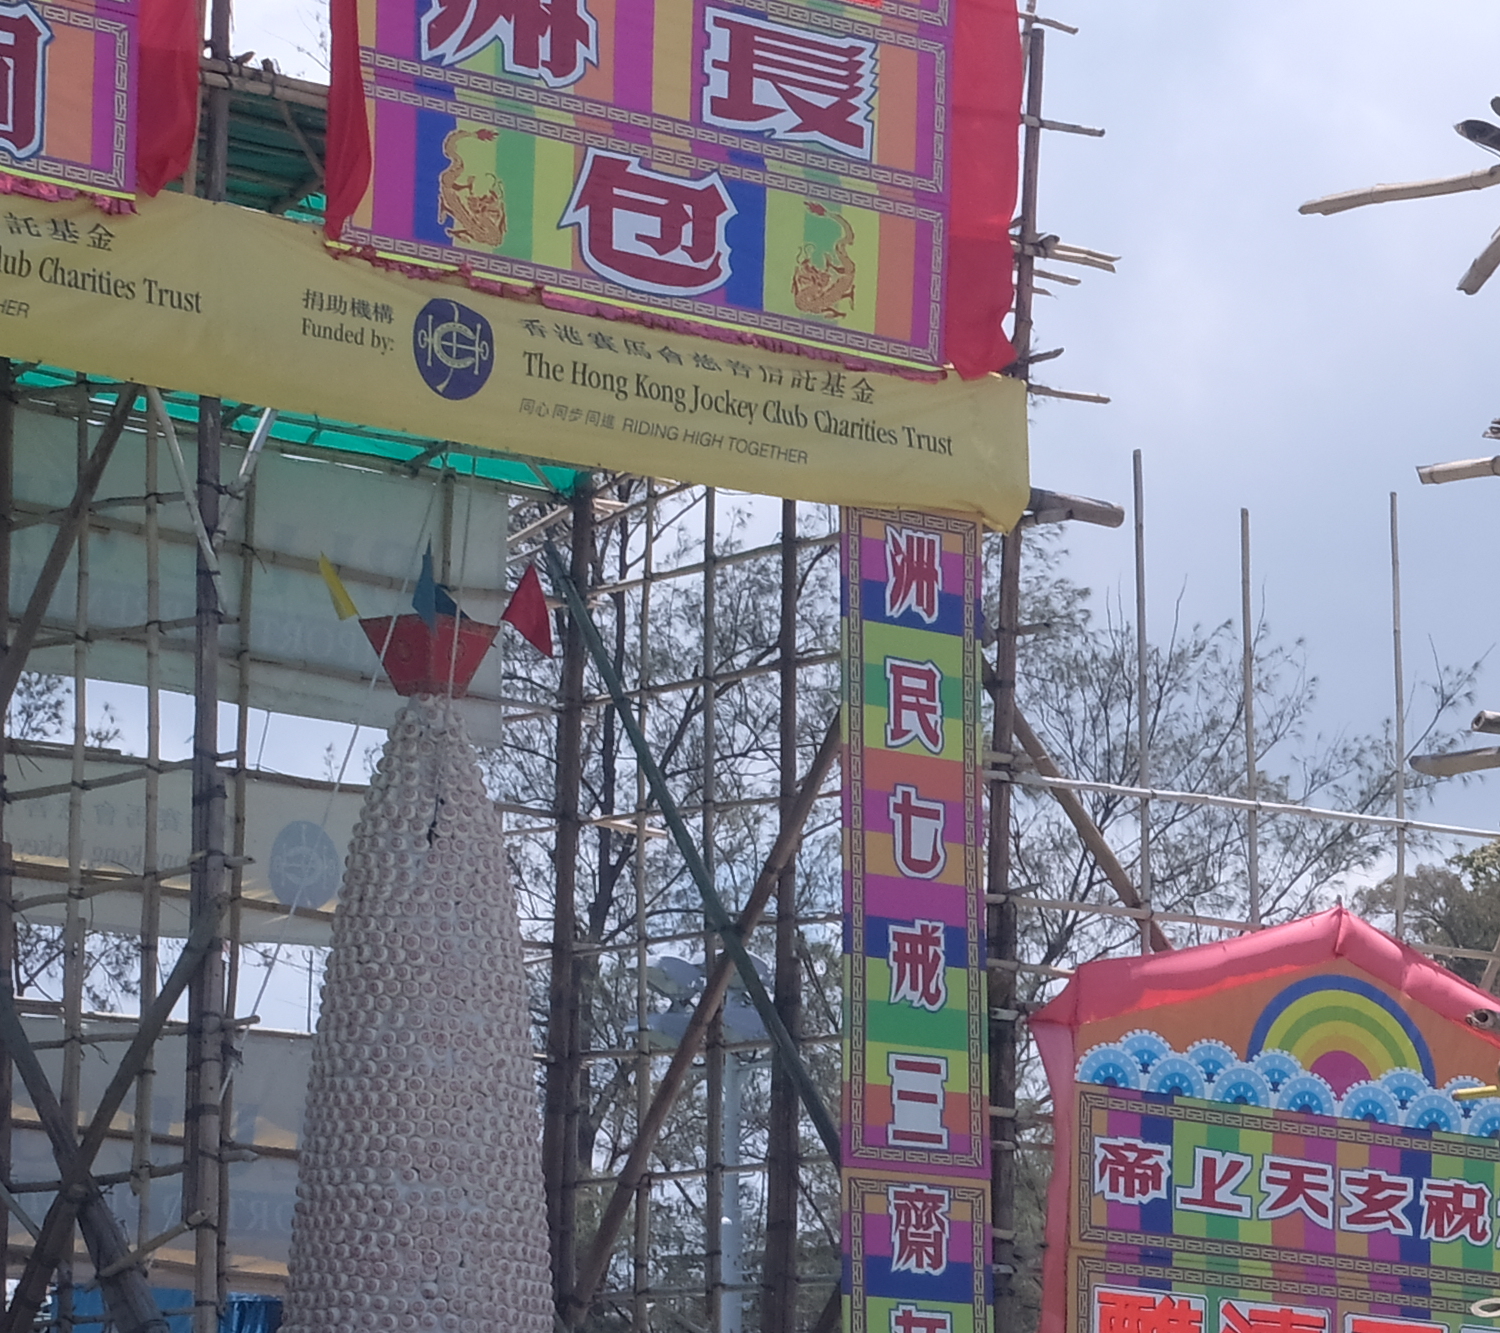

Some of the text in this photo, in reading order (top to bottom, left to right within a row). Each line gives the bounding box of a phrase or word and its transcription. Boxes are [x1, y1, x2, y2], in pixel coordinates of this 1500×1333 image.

[39, 254, 137, 304] Charities
[143, 276, 203, 318] Trust
[301, 287, 396, 326] 捐助機構
[301, 316, 394, 355] Funded by:
[519, 397, 615, 431] 同心同步同進
[523, 350, 953, 457] The Hong Kong Jockey Club Charities Trust
[622, 419, 808, 464] RIDING HIGH TOGETHER
